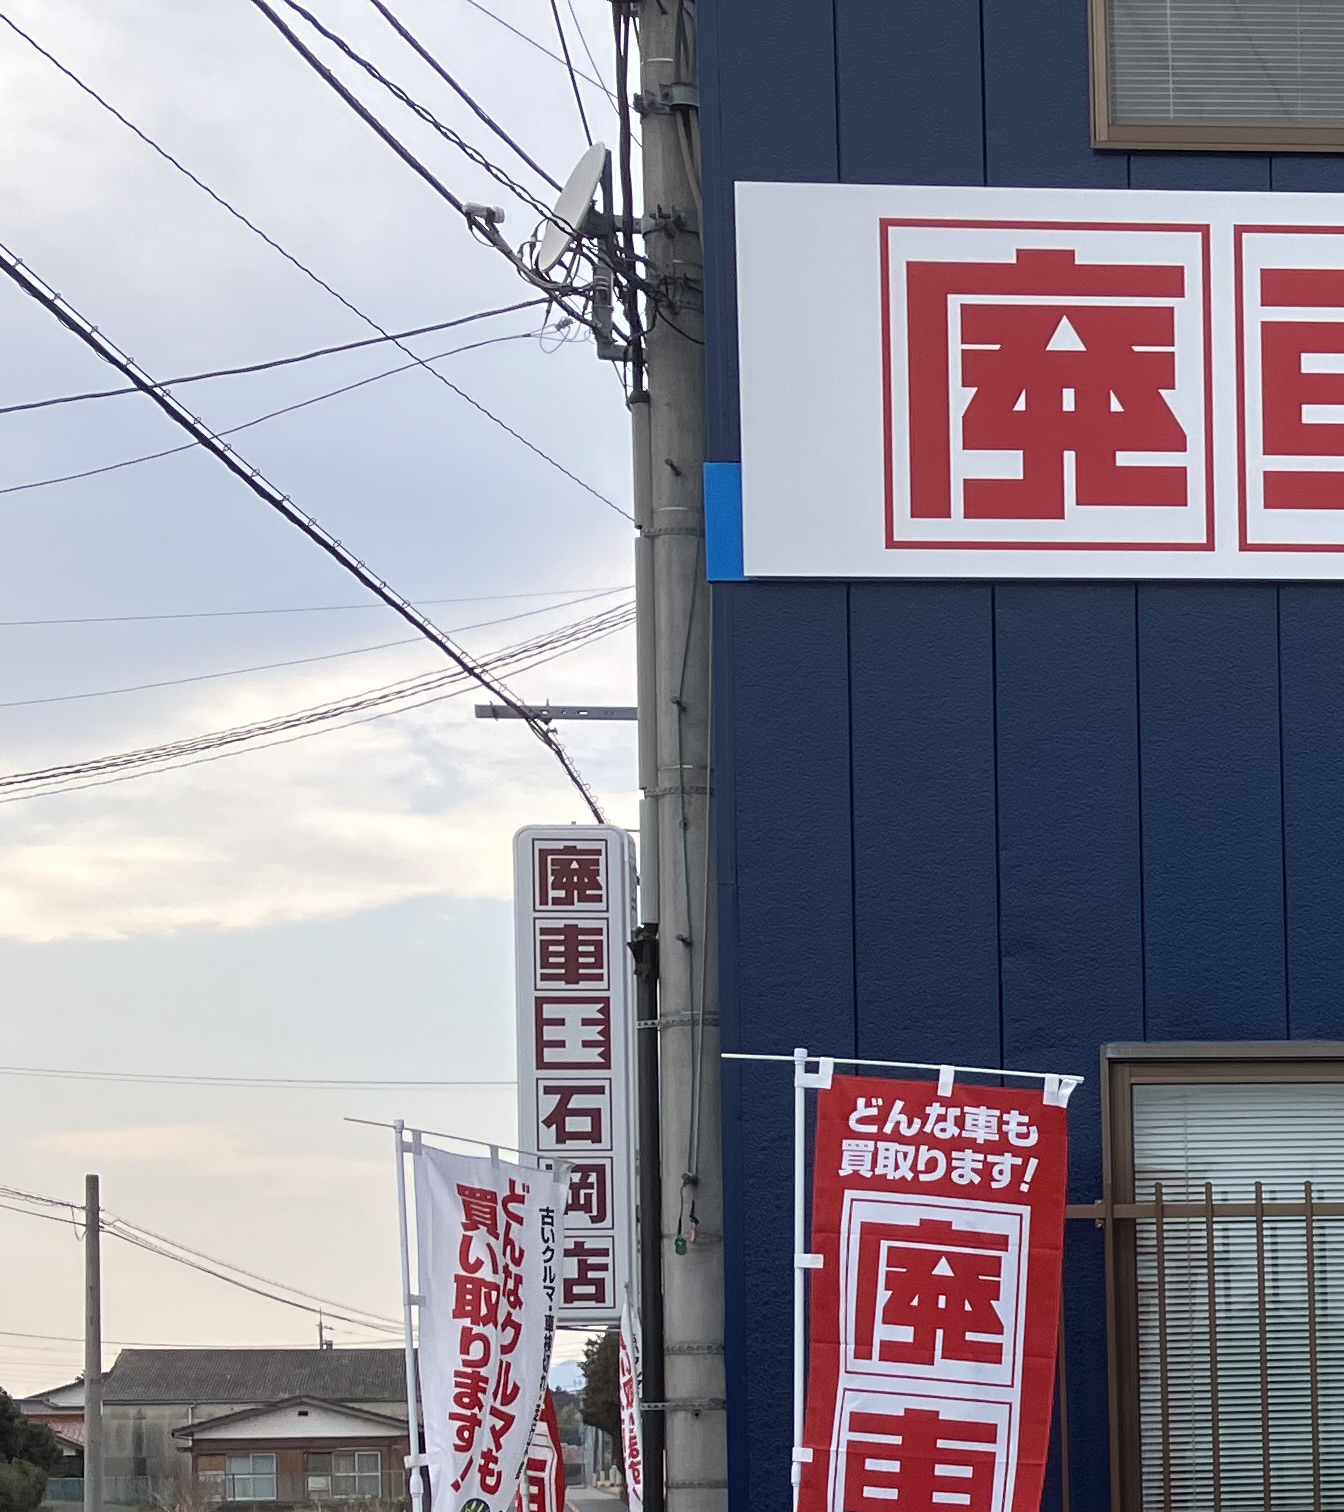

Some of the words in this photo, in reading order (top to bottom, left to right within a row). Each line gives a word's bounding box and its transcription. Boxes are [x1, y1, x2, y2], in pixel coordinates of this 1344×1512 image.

[538, 845, 611, 1306] 廃車王石岡店
[839, 1140, 1039, 1192] 買取ります!
[848, 1097, 1039, 1147] どんな車も
[477, 1177, 530, 1496] どんなクルマも
